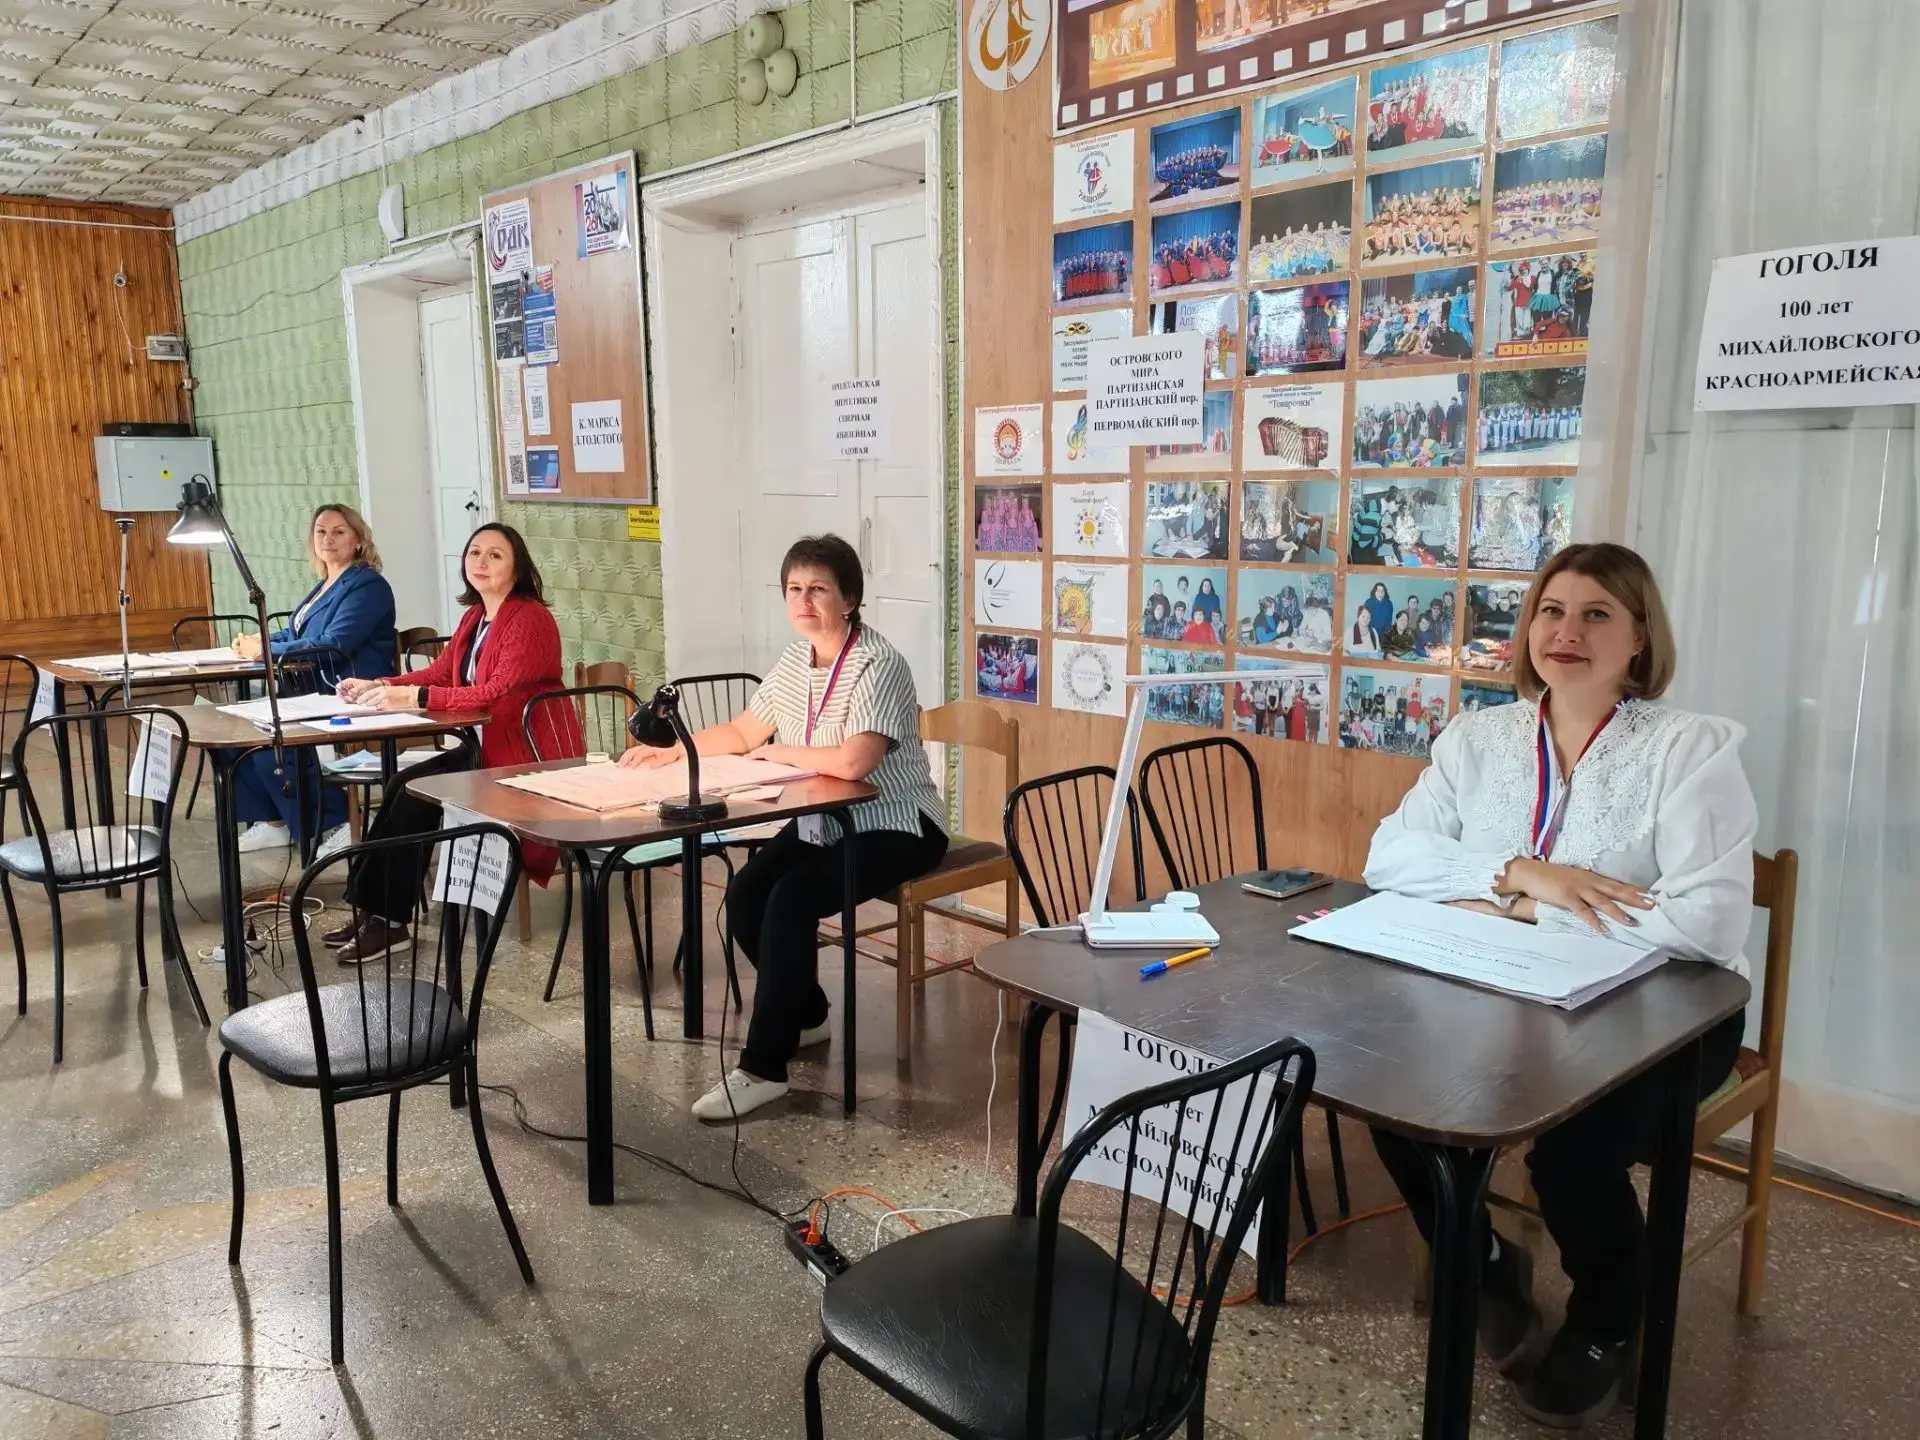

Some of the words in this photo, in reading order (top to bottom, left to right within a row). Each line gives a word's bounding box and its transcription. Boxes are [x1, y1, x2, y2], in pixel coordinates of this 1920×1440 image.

[1758, 246, 1879, 279] ГОГОЛЯ
[1779, 300, 1812, 319] 100
[1816, 300, 1854, 316] лет
[1718, 328, 1920, 357] МИХАЙЛОВСКОГО
[1110, 350, 1183, 367] ОСТРОВСКОГО
[1131, 367, 1159, 379] МИРА
[1107, 378, 1185, 395] ПАРТИЗАНСКАЯ
[1096, 391, 1178, 410] ПАРТИЗАНСКИЙ
[1180, 394, 1199, 406] пер.
[578, 418, 587, 430] К.
[588, 416, 620, 429] МАРКСА
[1094, 414, 1179, 432] ПЕРВОМАЙСКИЙ
[1181, 417, 1200, 429] пер.
